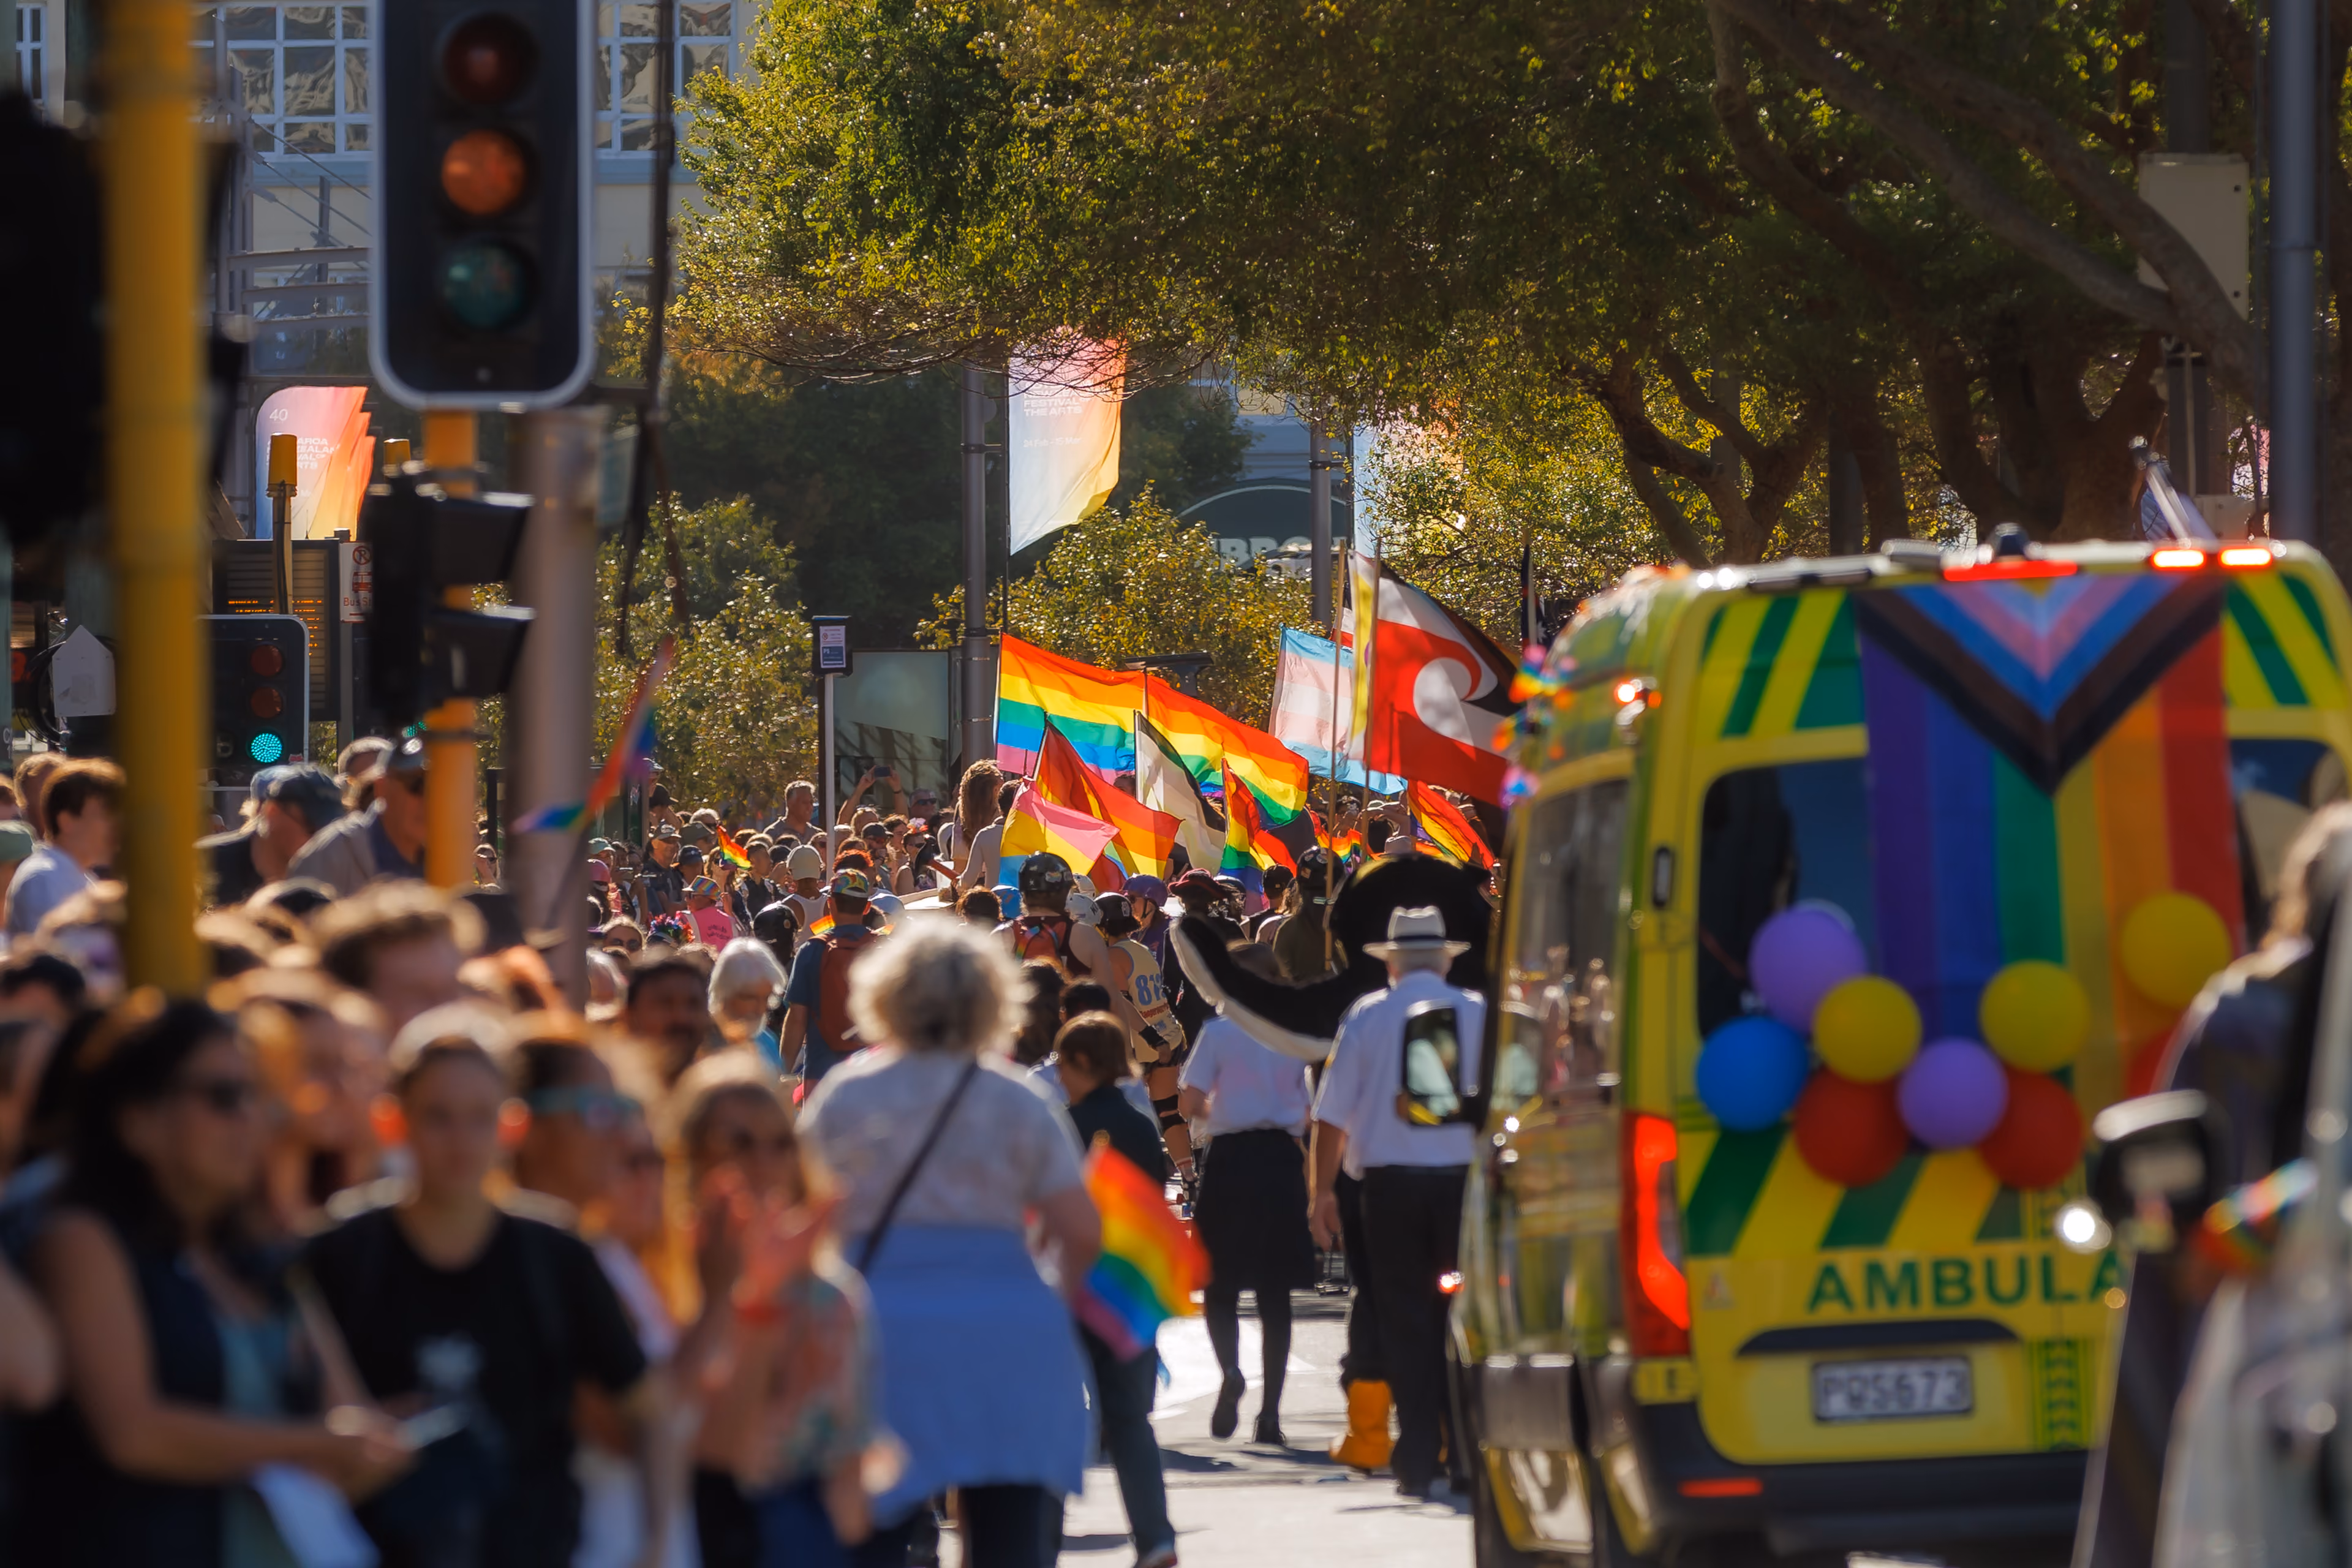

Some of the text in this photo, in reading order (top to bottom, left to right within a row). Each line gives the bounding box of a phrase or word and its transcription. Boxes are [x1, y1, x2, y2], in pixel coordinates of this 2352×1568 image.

[1023, 398, 1080, 408] FESTIVAL
[269, 409, 288, 421] 40
[1023, 405, 1082, 417] THE ARTS
[344, 597, 361, 606] Bus
